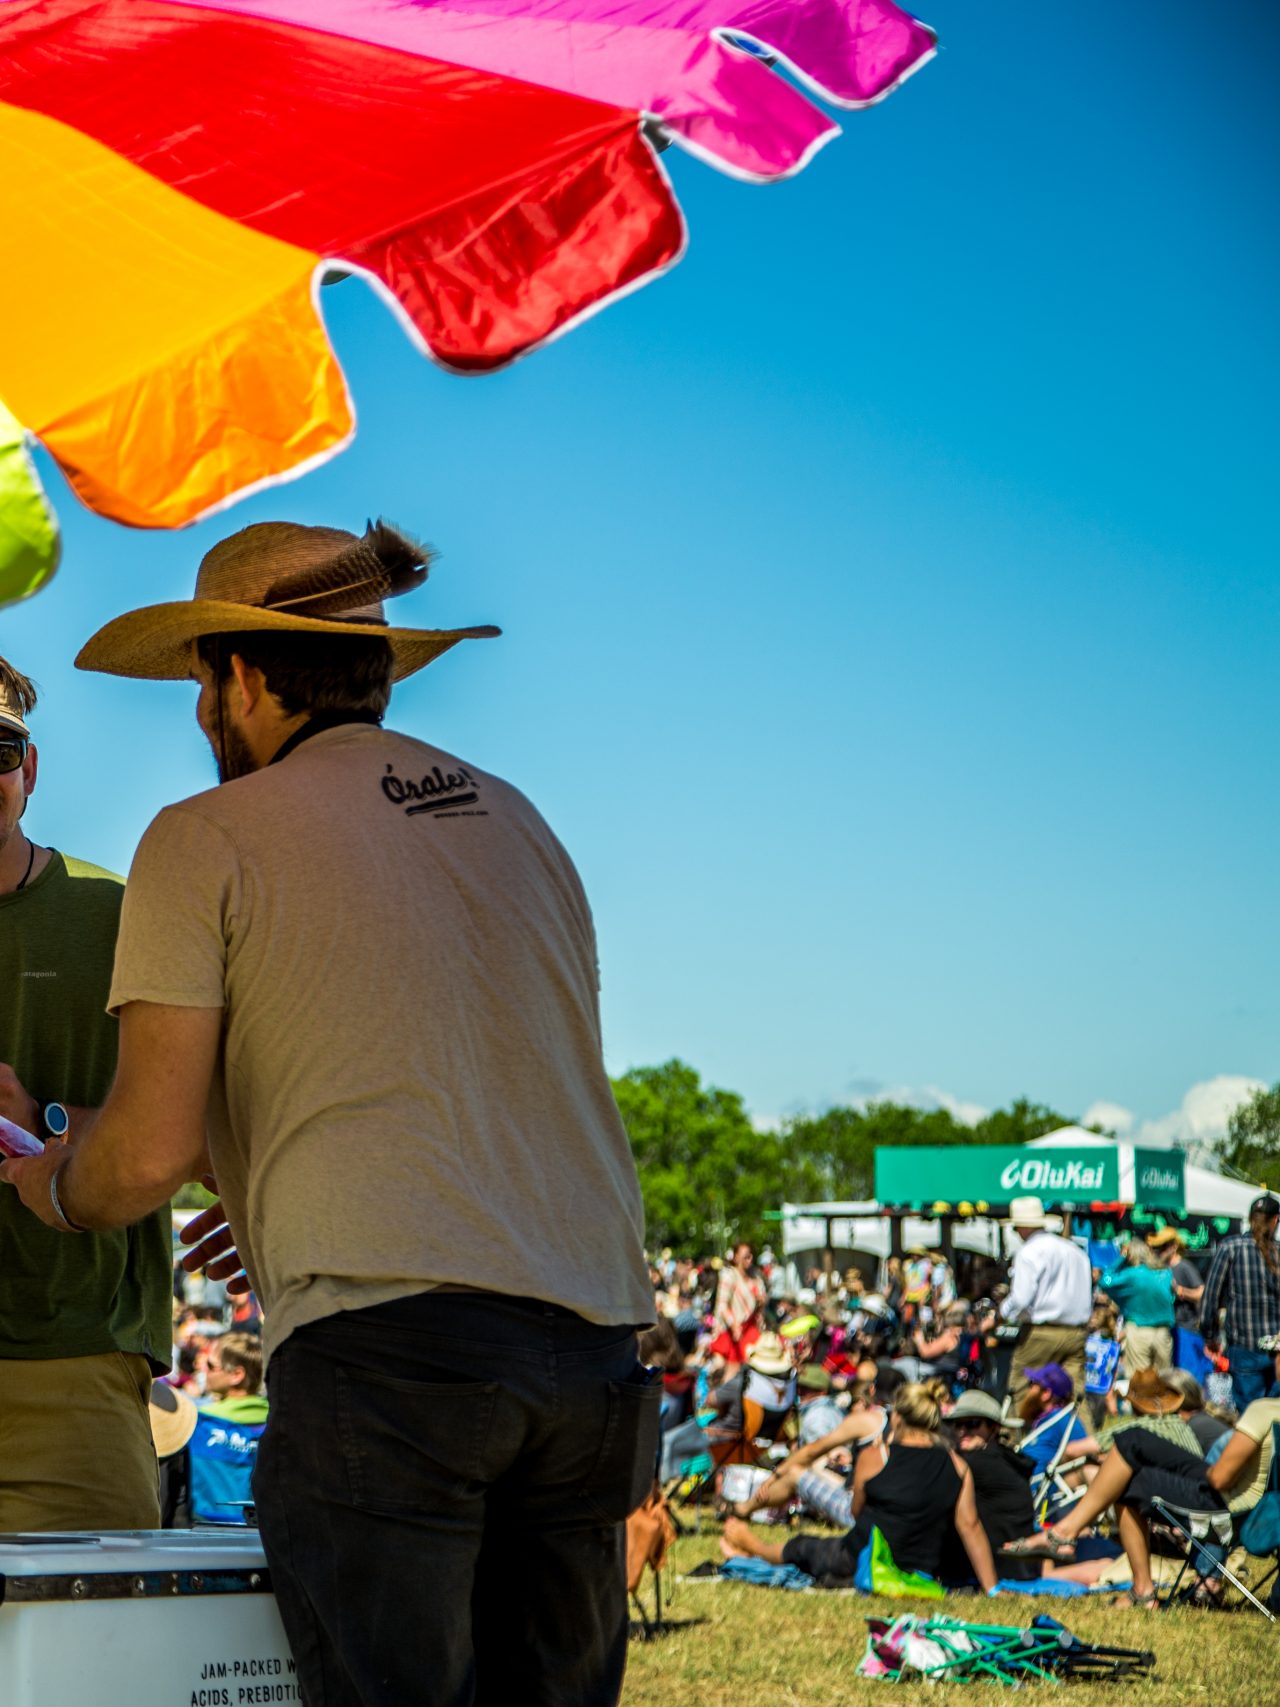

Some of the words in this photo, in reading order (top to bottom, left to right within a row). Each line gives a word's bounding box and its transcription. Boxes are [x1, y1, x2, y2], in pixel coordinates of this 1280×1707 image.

[17, 970, 57, 979] atagonia
[1019, 1160, 1104, 1189] OluKai
[201, 1659, 281, 1680] JAM-PACKED
[191, 1688, 233, 1707] ACIDS,
